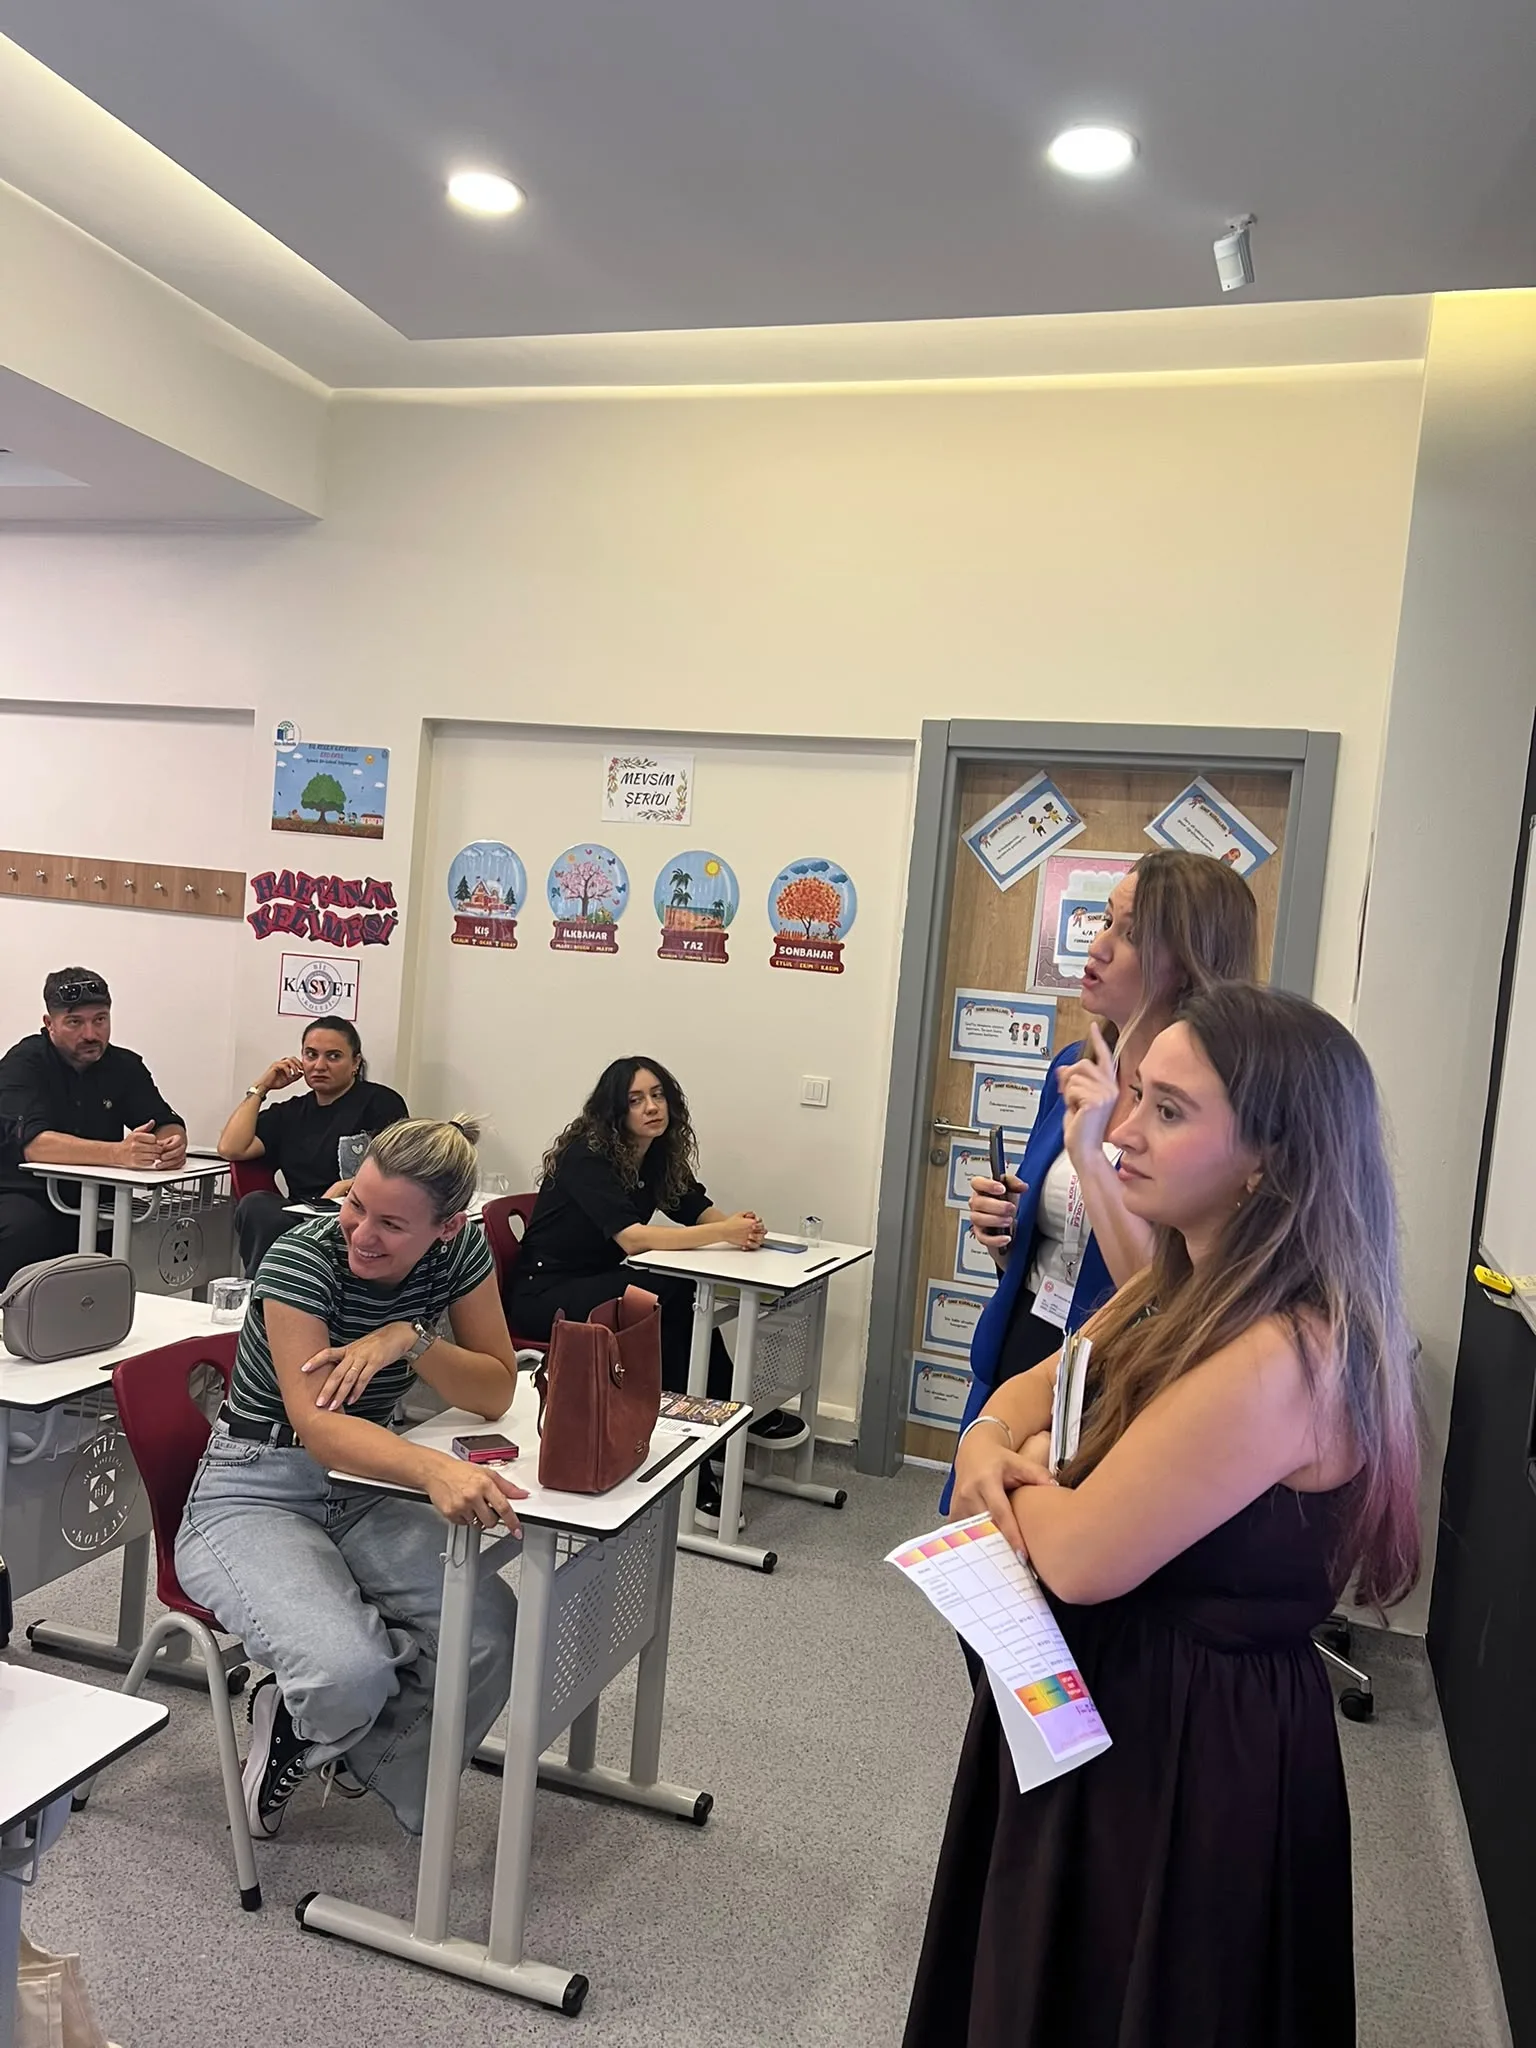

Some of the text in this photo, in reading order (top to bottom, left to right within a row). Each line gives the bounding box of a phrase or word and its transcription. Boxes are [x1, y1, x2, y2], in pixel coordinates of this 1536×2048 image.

[620, 771, 675, 787] MEVSİM
[624, 791, 672, 808] ŞERİDİ
[250, 869, 398, 910] HAFTANIN
[247, 902, 399, 948] KELİMESİ
[474, 926, 490, 938] KIŞ
[563, 927, 608, 940] İLKBAHAR
[682, 940, 704, 951] YAZ
[779, 946, 834, 960] SONBAHAR
[283, 977, 356, 998] KASVET
[93, 1437, 116, 1458] BİL
